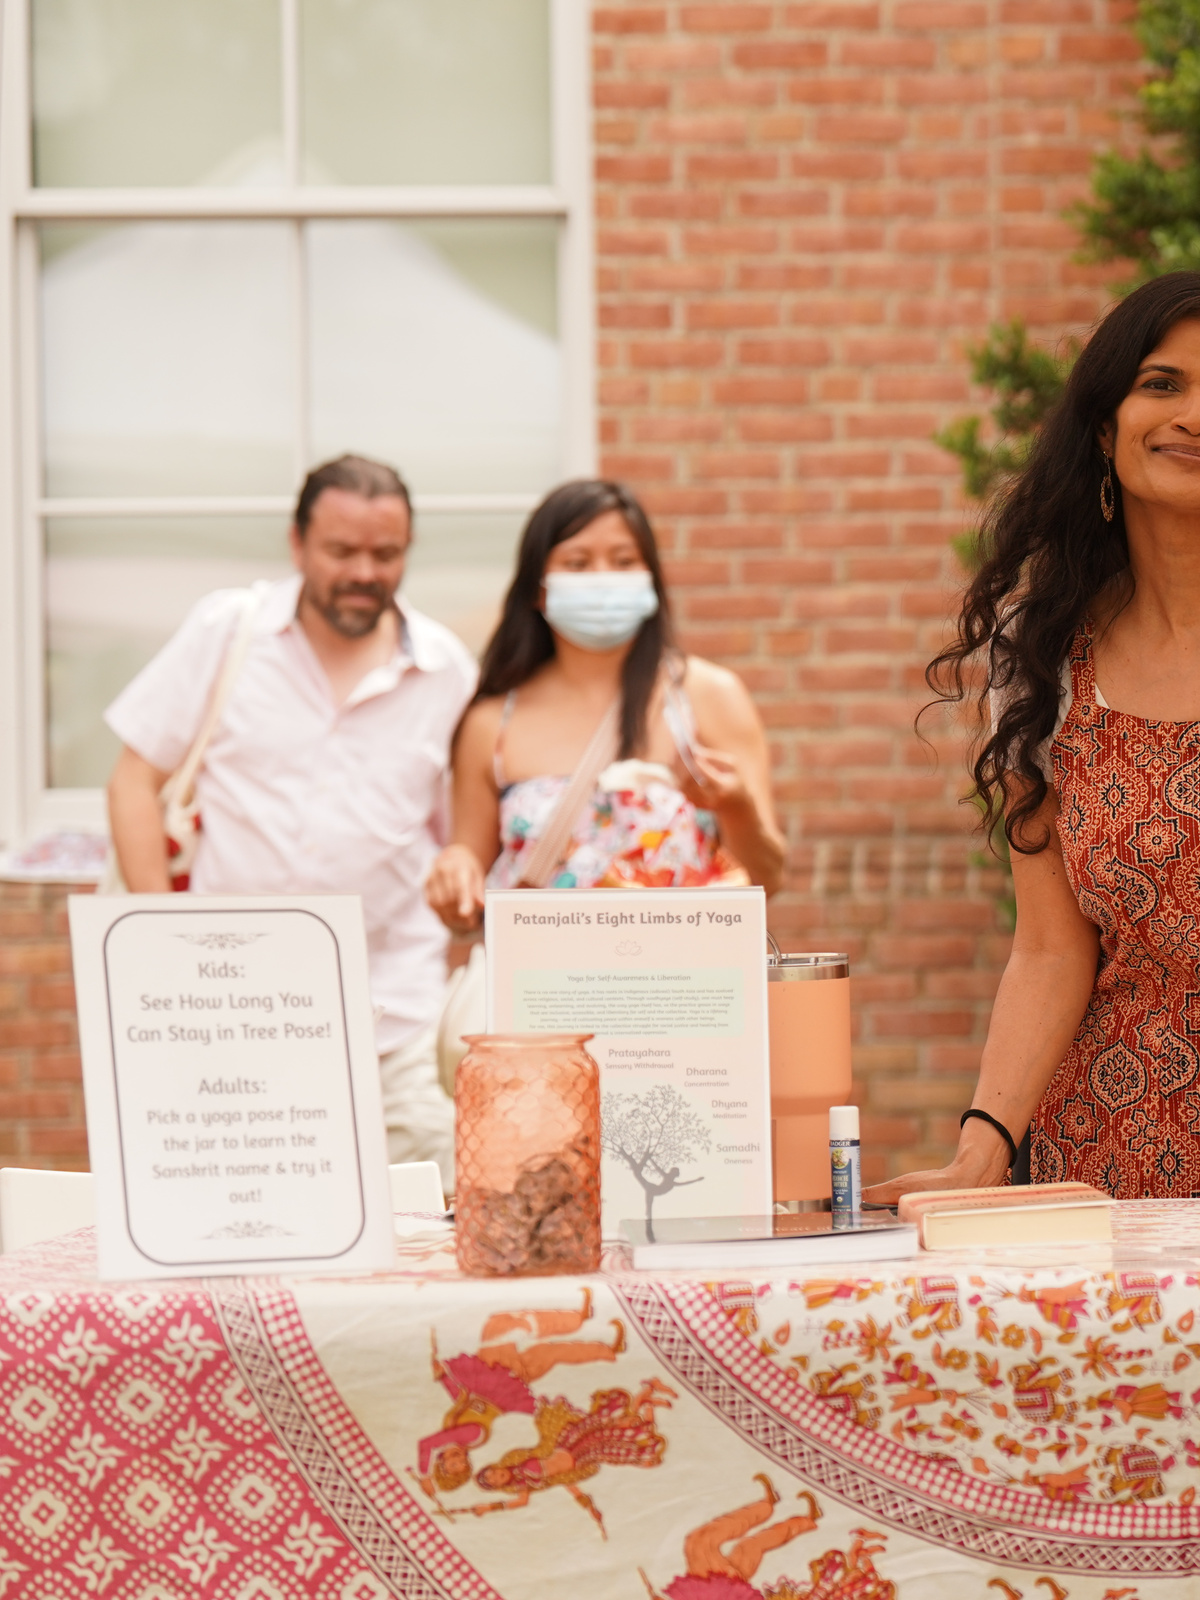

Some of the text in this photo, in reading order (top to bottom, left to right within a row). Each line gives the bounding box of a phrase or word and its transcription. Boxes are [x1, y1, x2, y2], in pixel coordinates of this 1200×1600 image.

[514, 911, 742, 927] Patanjali's Eight Limbs of Yoga
[197, 961, 245, 978] Kids:
[566, 975, 584, 983] Yoga
[139, 992, 313, 1013] See How Long You
[126, 1022, 331, 1045] Can Stay in Tree Pose!
[608, 1048, 671, 1059] Pratayahara
[604, 1062, 632, 1070] Sensory
[686, 1067, 727, 1076] Dharana
[198, 1077, 266, 1094] Adults:
[711, 1099, 748, 1110] Dhyana
[146, 1105, 328, 1127] Pick a yoga pose from
[163, 1133, 316, 1153] the jar to learn the
[716, 1143, 760, 1152] Samadhi
[152, 1159, 332, 1179] Sanskrit name & try it
[228, 1188, 261, 1203] out!
